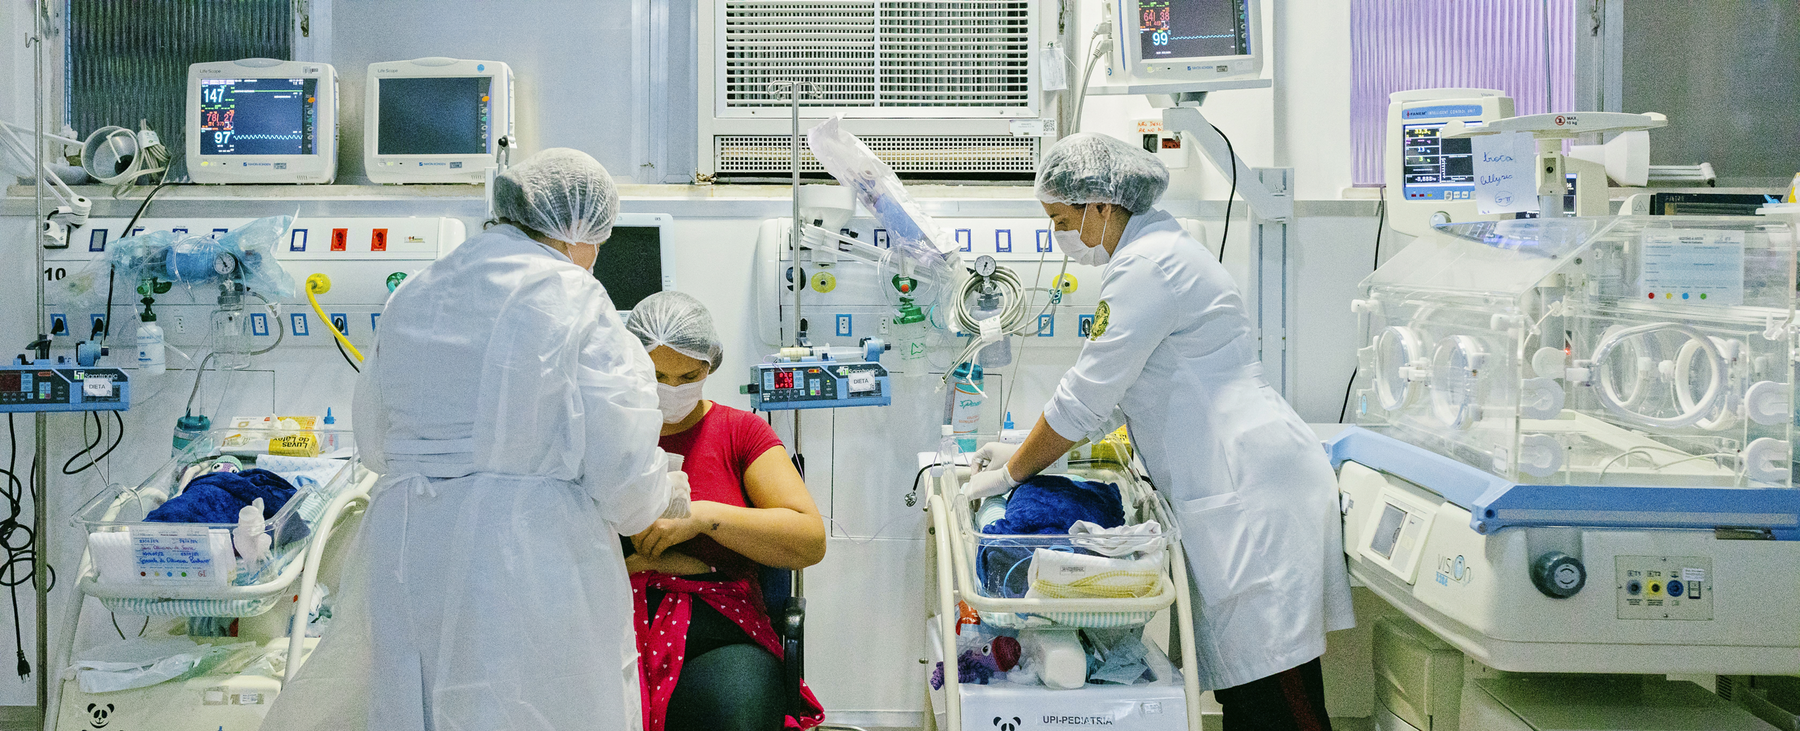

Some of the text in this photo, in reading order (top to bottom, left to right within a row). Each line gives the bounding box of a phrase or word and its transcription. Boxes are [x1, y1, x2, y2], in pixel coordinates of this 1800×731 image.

[1152, 32, 1169, 46] 99
[203, 88, 224, 103] 147
[214, 131, 231, 144] 97
[44, 267, 67, 281] 10
[1042, 715, 1113, 726] UPI-PEDIATRIA
